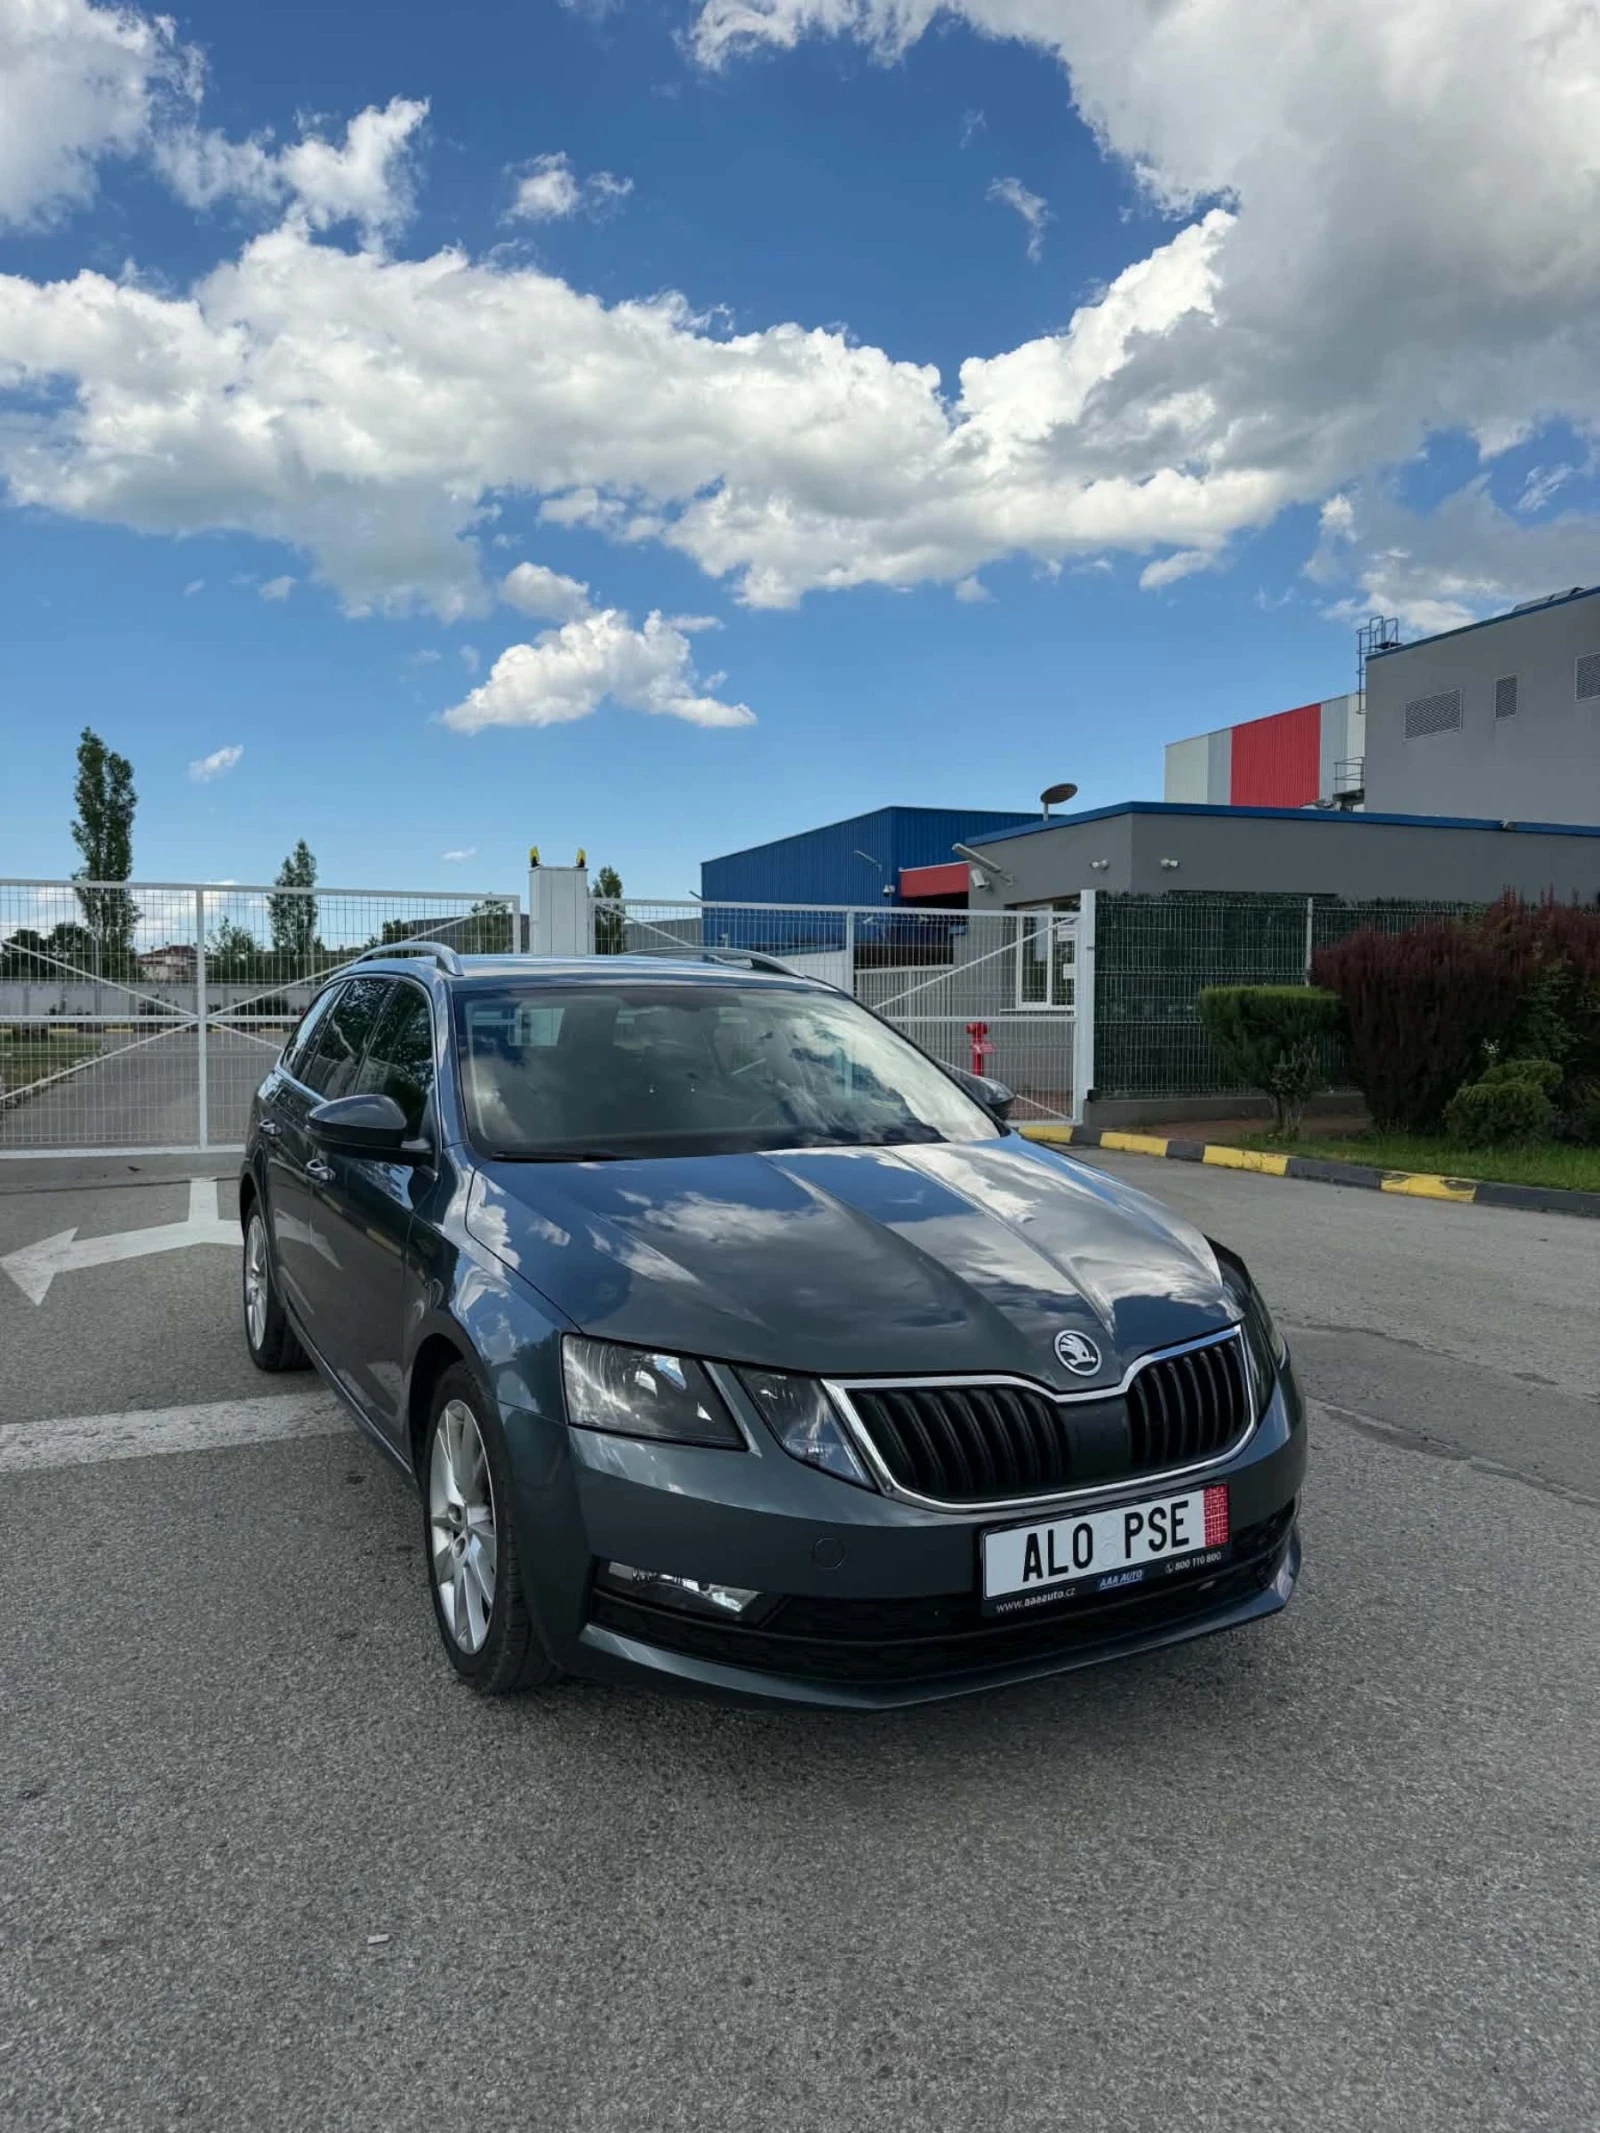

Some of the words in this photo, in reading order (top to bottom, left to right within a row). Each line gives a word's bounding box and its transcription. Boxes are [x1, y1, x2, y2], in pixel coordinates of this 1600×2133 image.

[1022, 1522, 1093, 1582] ALO
[1124, 1500, 1190, 1559] PSE
[1100, 1575, 1119, 1588] AAA
[1120, 1569, 1144, 1582] AUTO
[996, 1587, 1076, 1613] www.aaaauto.cz
